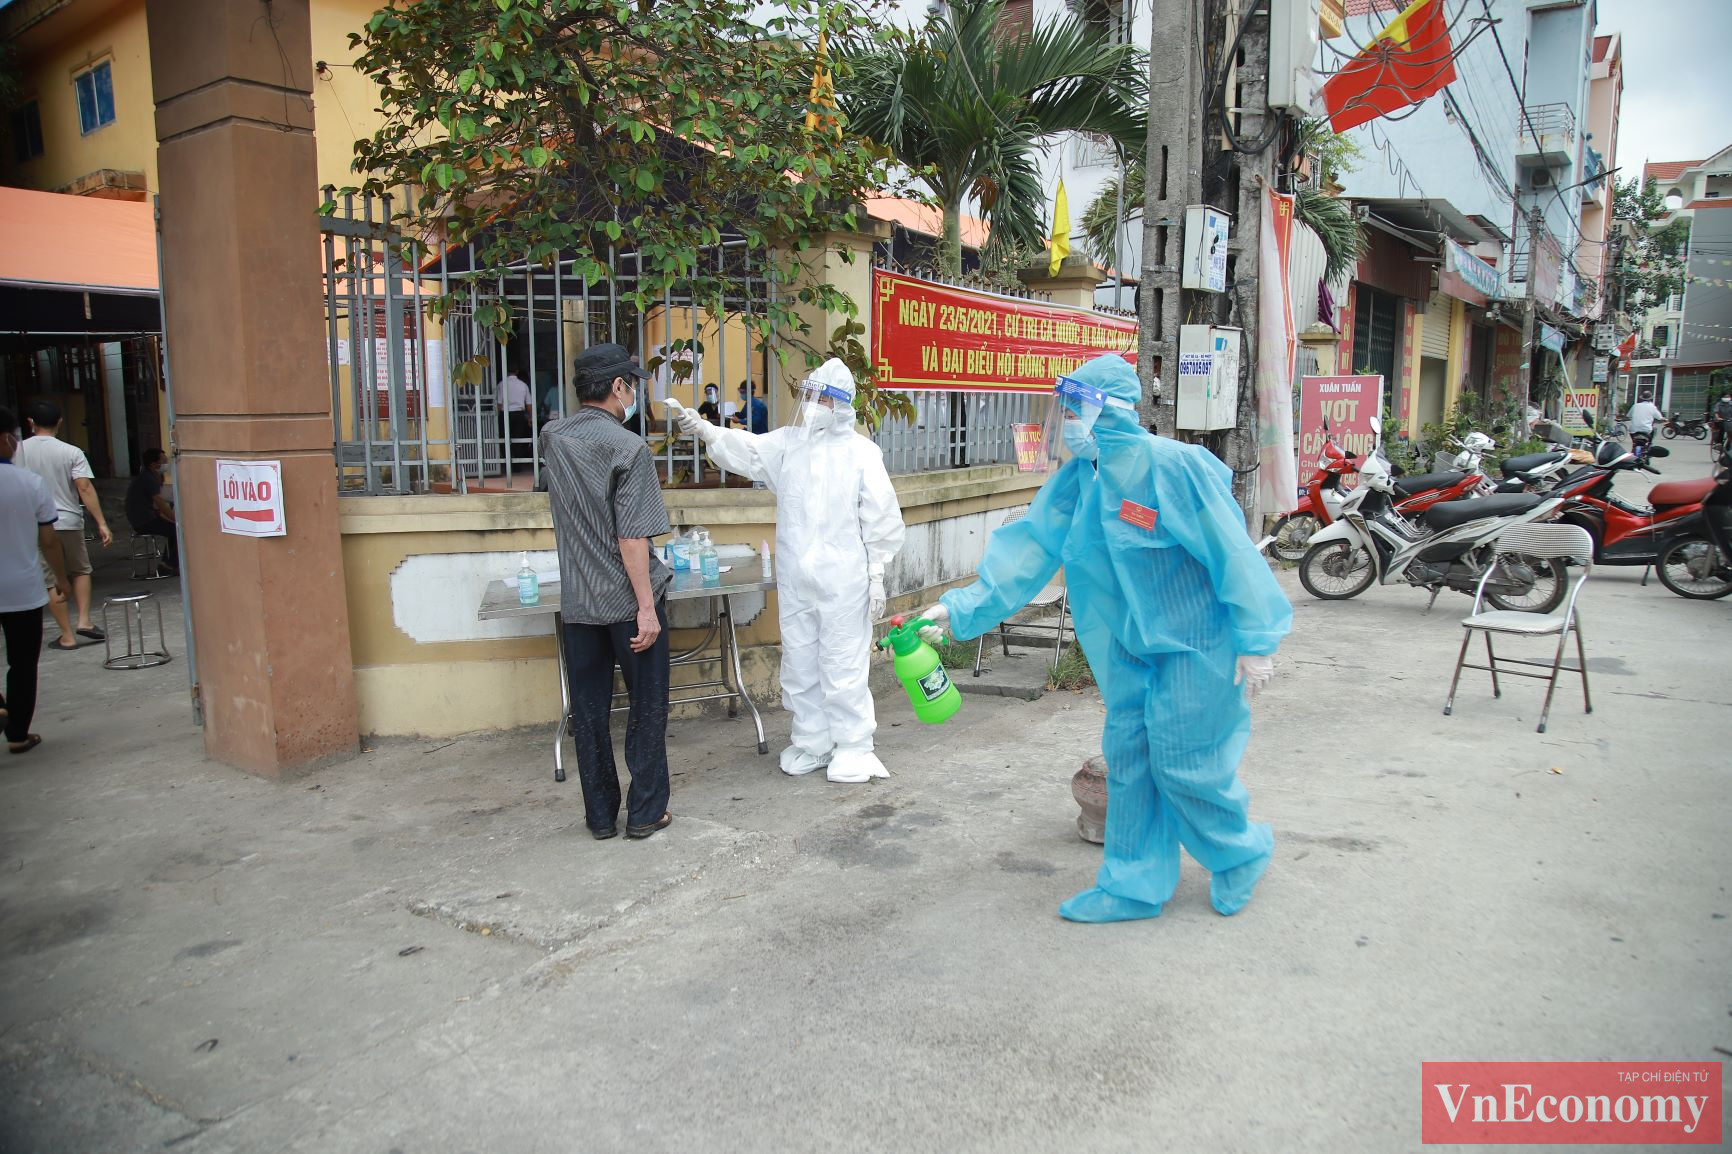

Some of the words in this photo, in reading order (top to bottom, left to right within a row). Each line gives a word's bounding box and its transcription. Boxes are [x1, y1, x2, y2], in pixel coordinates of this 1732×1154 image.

[899, 296, 937, 328] NGÀY
[939, 304, 1002, 339] 23/5/2021,
[1005, 304, 1020, 338] CỬ
[1022, 315, 1037, 340] TRI
[922, 341, 939, 372] VÀ
[942, 347, 963, 379] ĐẠI
[967, 341, 994, 376] BIỂU
[996, 347, 1015, 381] HỘI
[1018, 346, 1046, 378] ĐỒNG
[1048, 353, 1074, 378] NHÂN
[1319, 382, 1340, 393] XUÂN
[1342, 381, 1361, 393] TUẤN
[1320, 399, 1359, 427] VỢT
[1337, 428, 1374, 456] ÔNG
[223, 473, 239, 500] LỐI
[242, 477, 272, 501] VÀO
